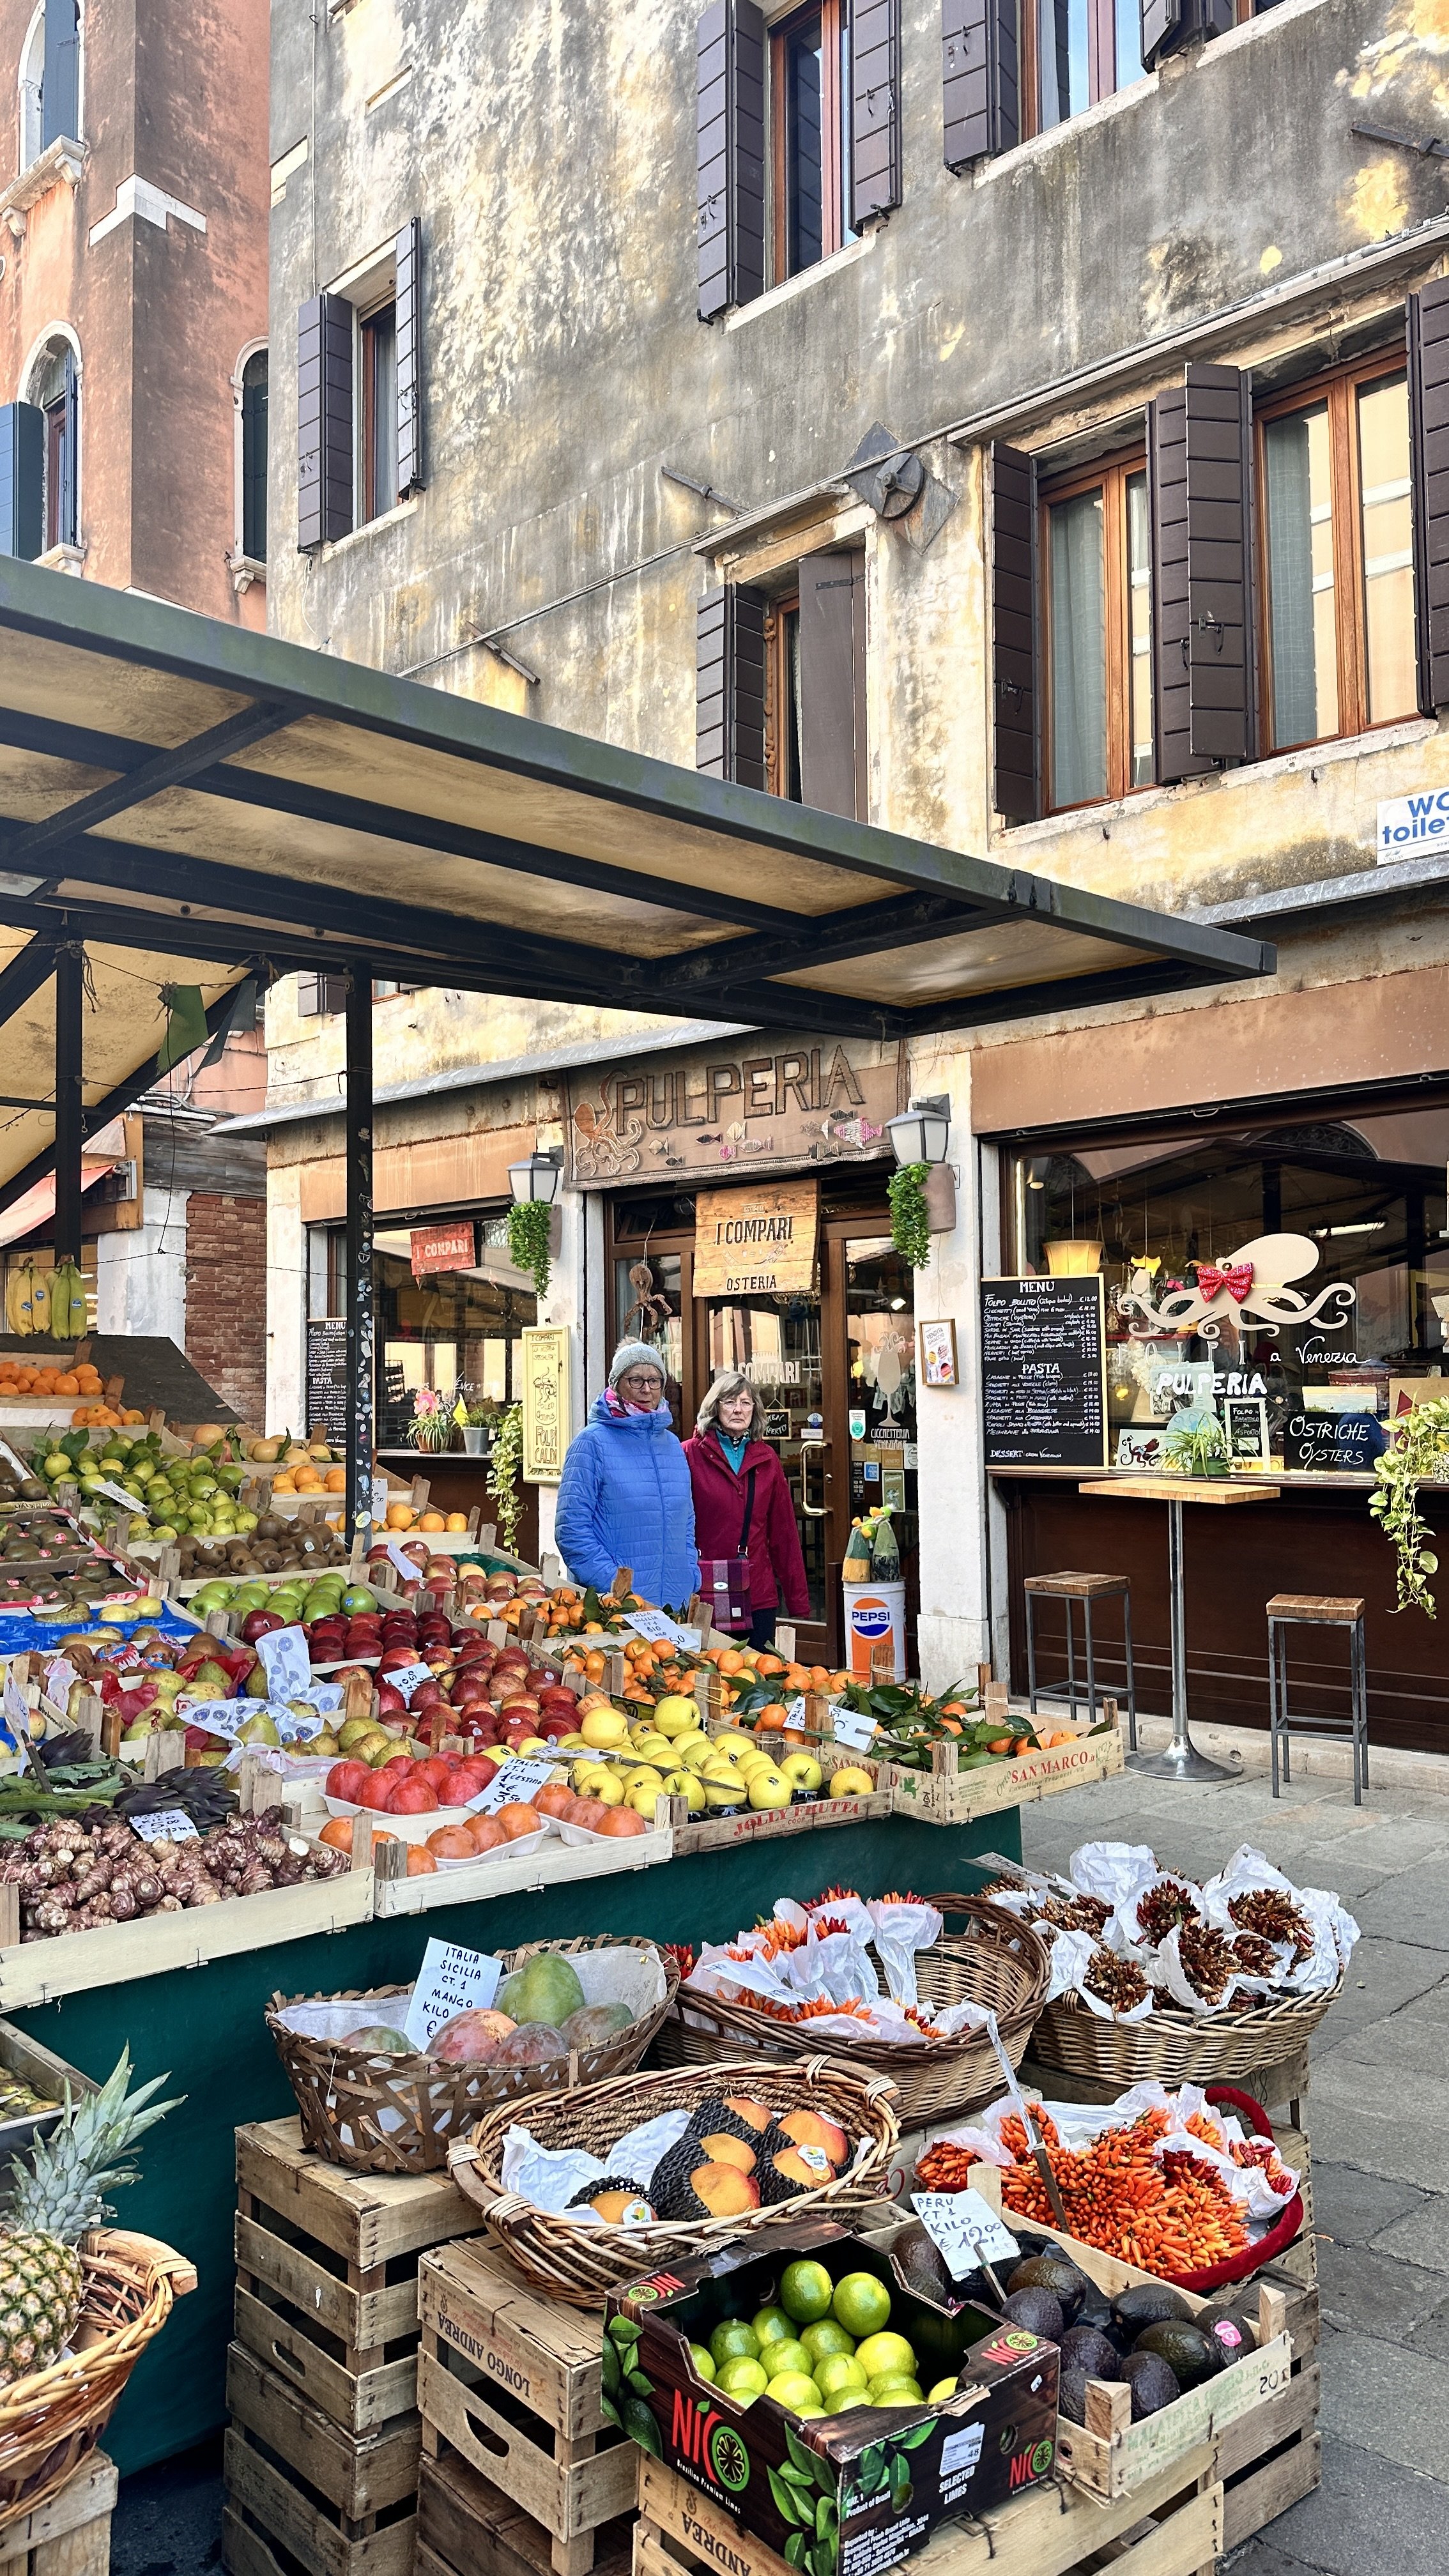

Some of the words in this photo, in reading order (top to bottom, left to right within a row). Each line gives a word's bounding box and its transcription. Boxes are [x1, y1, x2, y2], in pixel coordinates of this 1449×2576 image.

[1383, 817, 1449, 844] toile
[615, 1045, 866, 1136] PULPERIA
[716, 1223, 723, 1245] I
[726, 1216, 793, 1245] COMPARI
[416, 1246, 420, 1260] I
[424, 1238, 469, 1257] COMPARI
[726, 1275, 777, 1291] OSTERIA
[1019, 1281, 1055, 1292] MENU
[325, 1321, 346, 1330] MENU
[1295, 1336, 1372, 1365] Venezia
[1022, 1363, 1061, 1374] PASTA
[1155, 1372, 1268, 1395] PULPERIA
[535, 1426, 558, 1447] FOLPI
[871, 1429, 910, 1439] CICCHETTERIA
[1289, 1414, 1370, 1441] OSTRICHE
[873, 1439, 907, 1450] VENEZIANA
[1300, 1441, 1364, 1469] OYSTERS
[535, 1448, 557, 1464] CALDI
[852, 1611, 891, 1621] PEPSI
[788, 1702, 803, 1724] ITALIA
[510, 1758, 540, 1768] ITALIA
[1011, 1765, 1038, 1784] SAN
[1041, 1751, 1089, 1774] MARCO
[733, 1808, 788, 1837] JOLLY
[794, 1802, 859, 1818] FRUTTA
[788, 1817, 806, 1825] COOP
[445, 1946, 480, 1965] ITALIA
[440, 1959, 481, 1980] SICILIA
[431, 1988, 473, 2009] MANGO
[422, 2000, 449, 2019] KILO
[425, 2021, 437, 2039] €
[917, 2196, 953, 2209] PERU
[923, 2211, 940, 2221] CT
[930, 2217, 972, 2235] KILO
[939, 2237, 954, 2252] €
[438, 2311, 484, 2360] ANDREA
[487, 2351, 531, 2398] LONGO
[967, 2448, 979, 2458] 48
[677, 2458, 700, 2482] Brazilian
[701, 2476, 723, 2501] Premium
[725, 2496, 741, 2514] Limes
[939, 2465, 976, 2494] SELECTED
[846, 2502, 868, 2518] Product
[868, 2497, 875, 2508] of
[875, 2490, 891, 2504] Brazil
[860, 2493, 864, 2501] 1
[944, 2483, 967, 2505] LIMES
